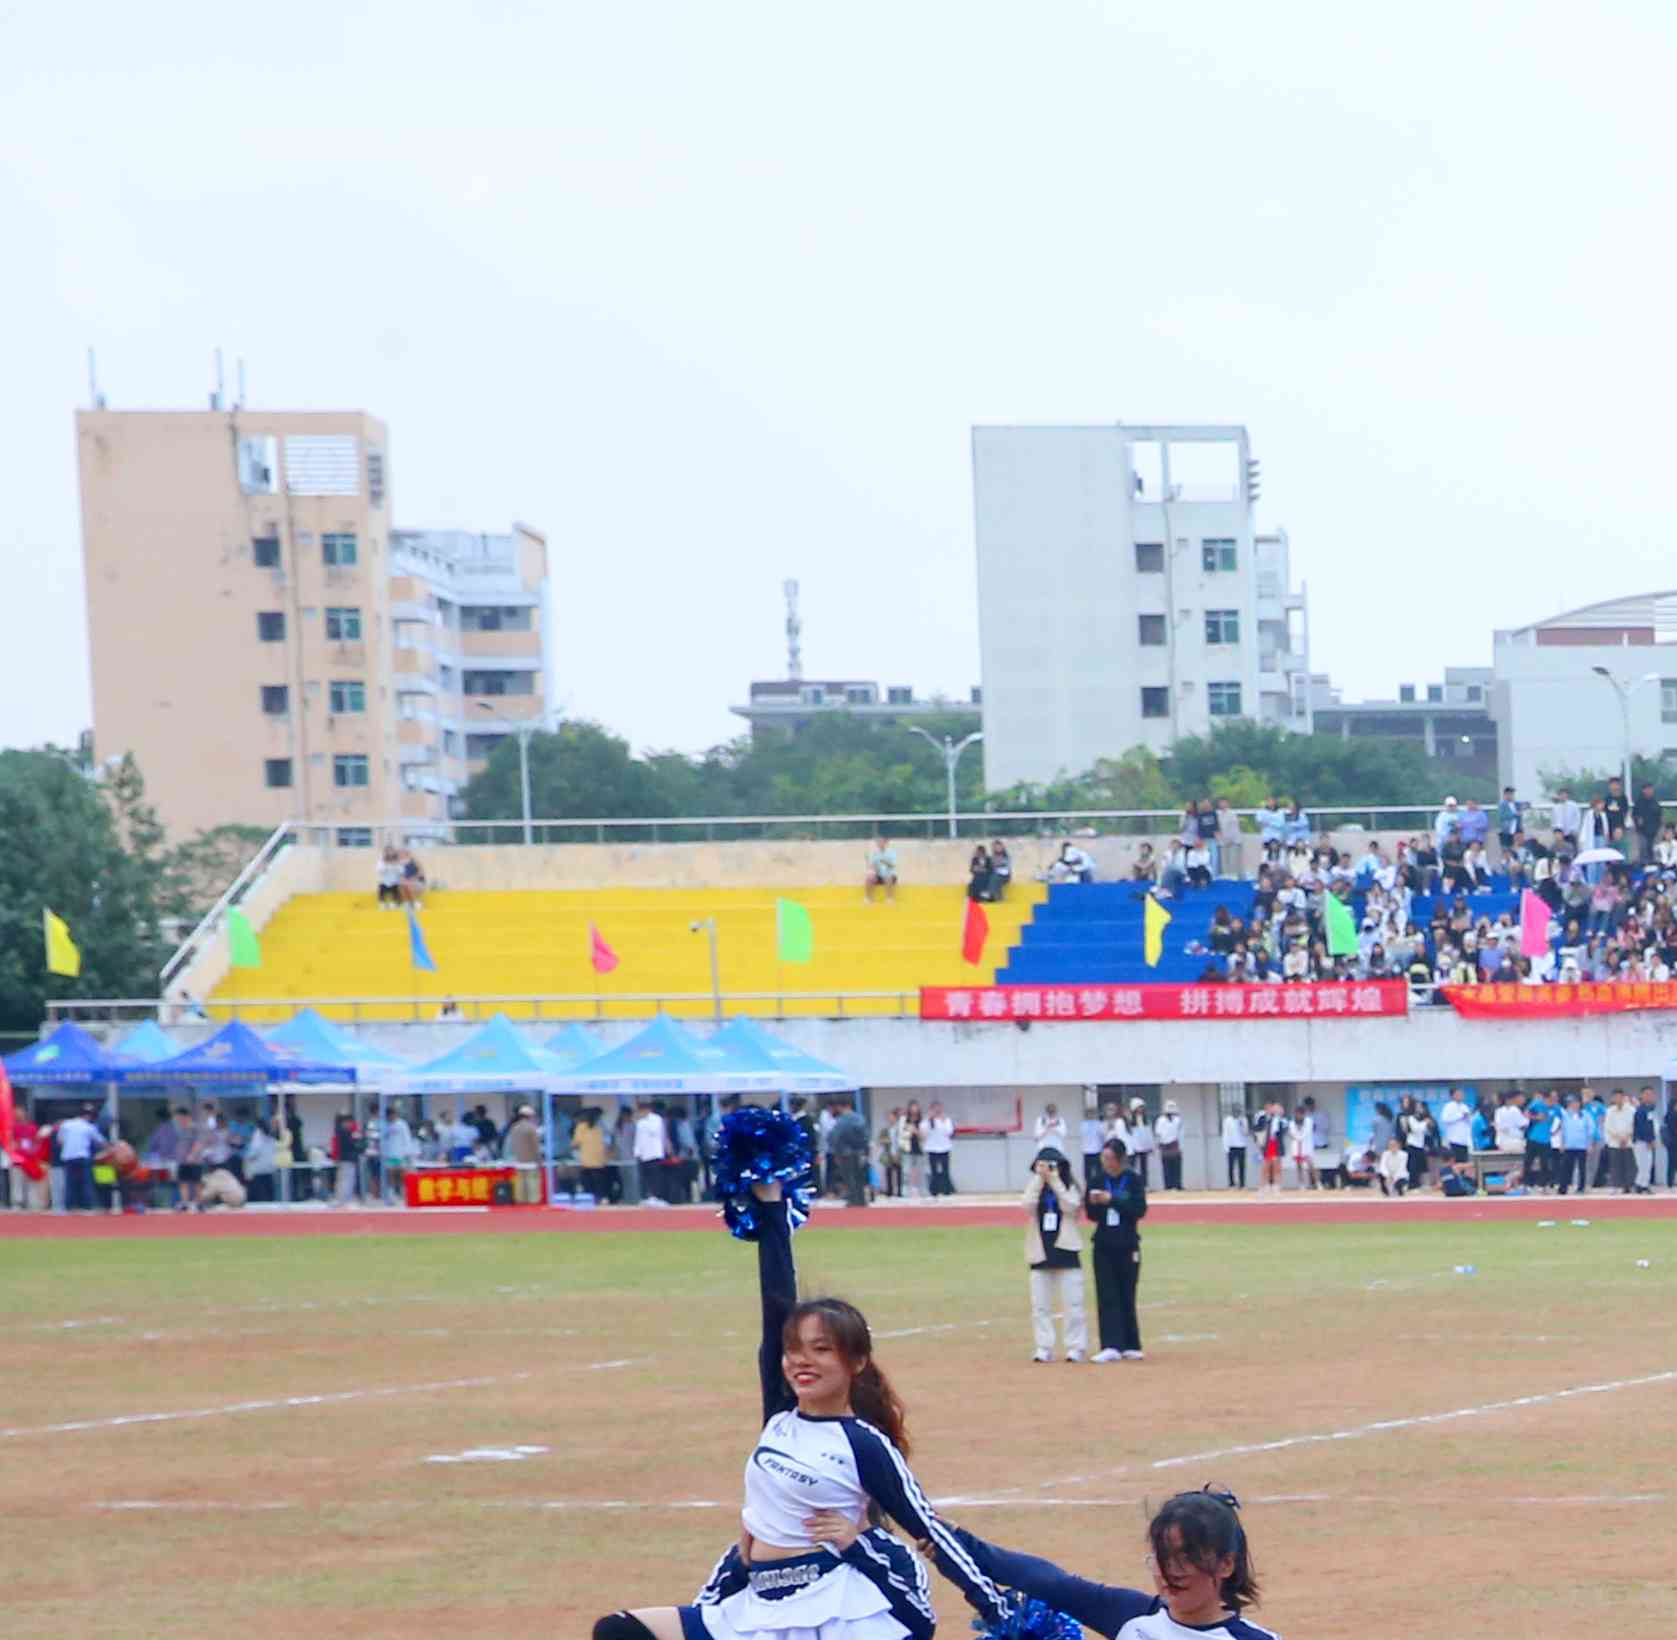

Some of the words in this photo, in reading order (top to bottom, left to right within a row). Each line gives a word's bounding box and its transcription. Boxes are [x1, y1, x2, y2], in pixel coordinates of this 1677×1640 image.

[945, 989, 1144, 1017] 青春拥抱梦想
[1180, 986, 1384, 1015] 拼搏成就辉煌
[763, 1458, 819, 1487] FANTASY
